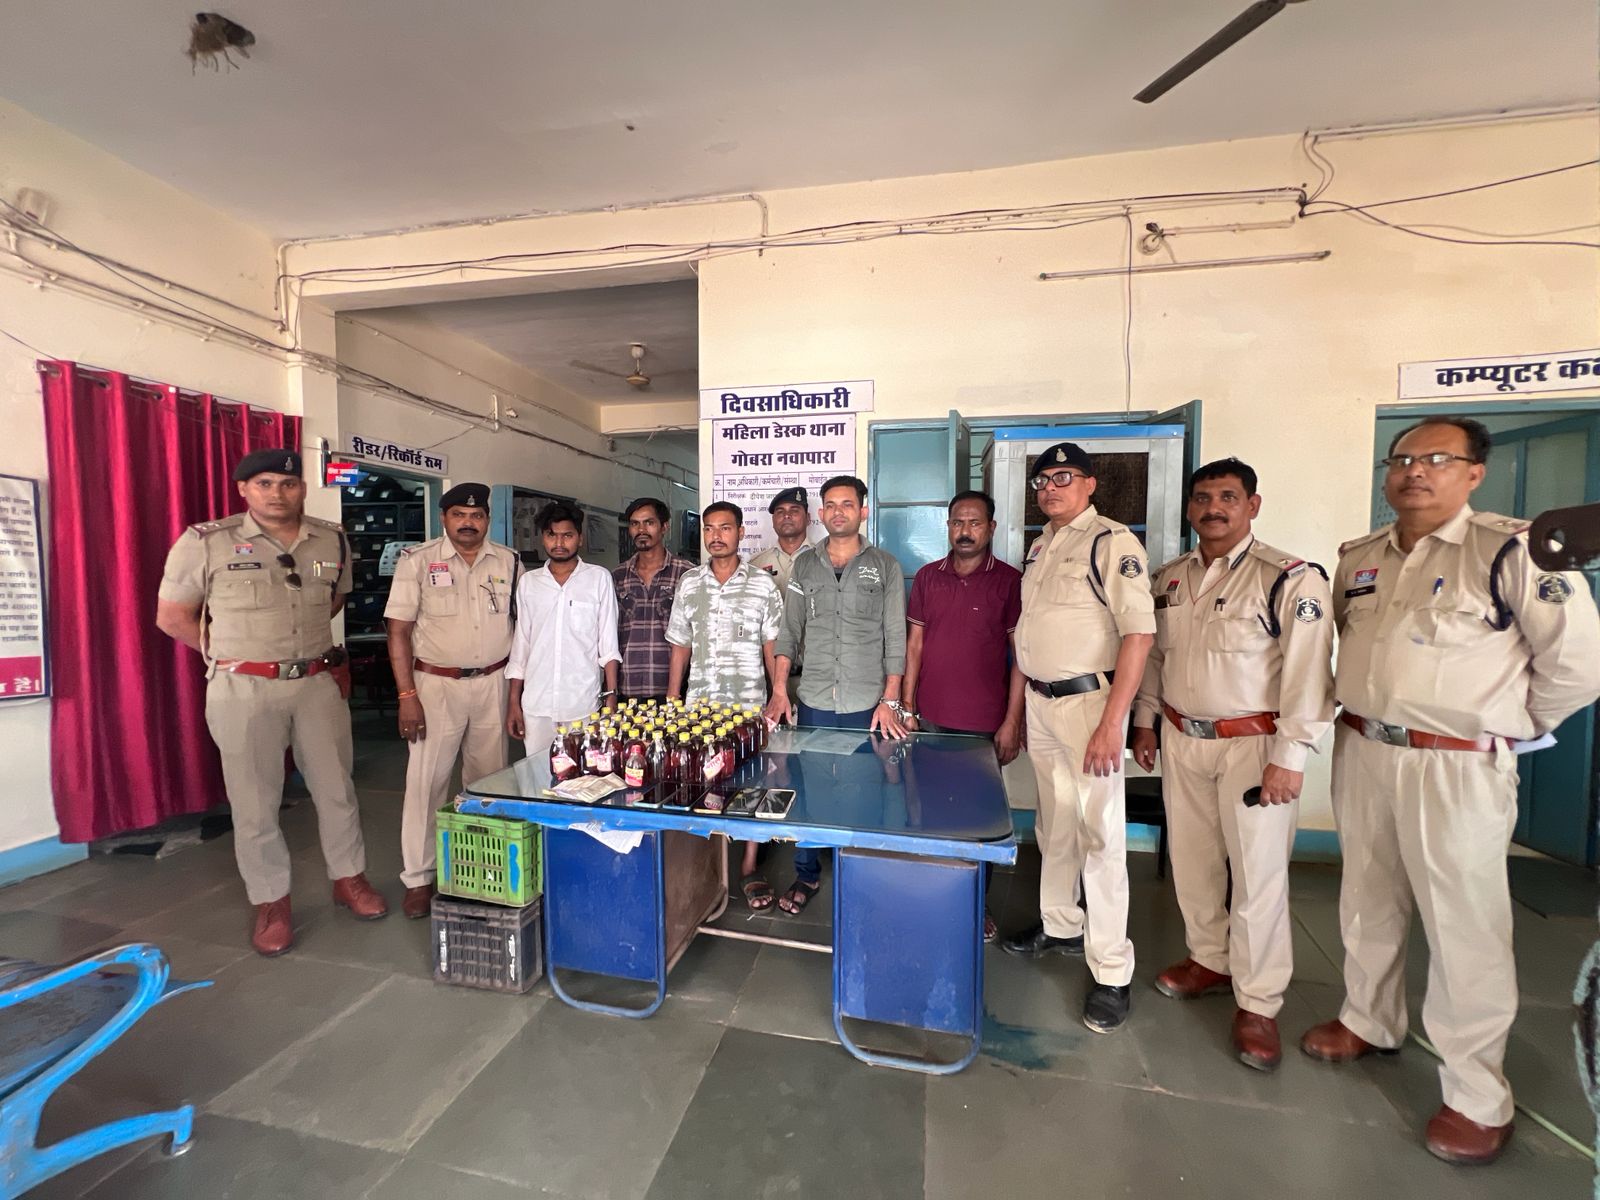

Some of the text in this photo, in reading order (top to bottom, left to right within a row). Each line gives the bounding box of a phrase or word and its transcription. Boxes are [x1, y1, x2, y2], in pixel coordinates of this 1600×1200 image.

[1435, 361, 1551, 392] कम्प्यूटर
[721, 387, 851, 414] दिवसाधिकारी
[722, 422, 846, 440] महिला डेस्क थाना
[424, 454, 442, 470] रूम
[731, 450, 836, 467] गोबरा नवापारा
